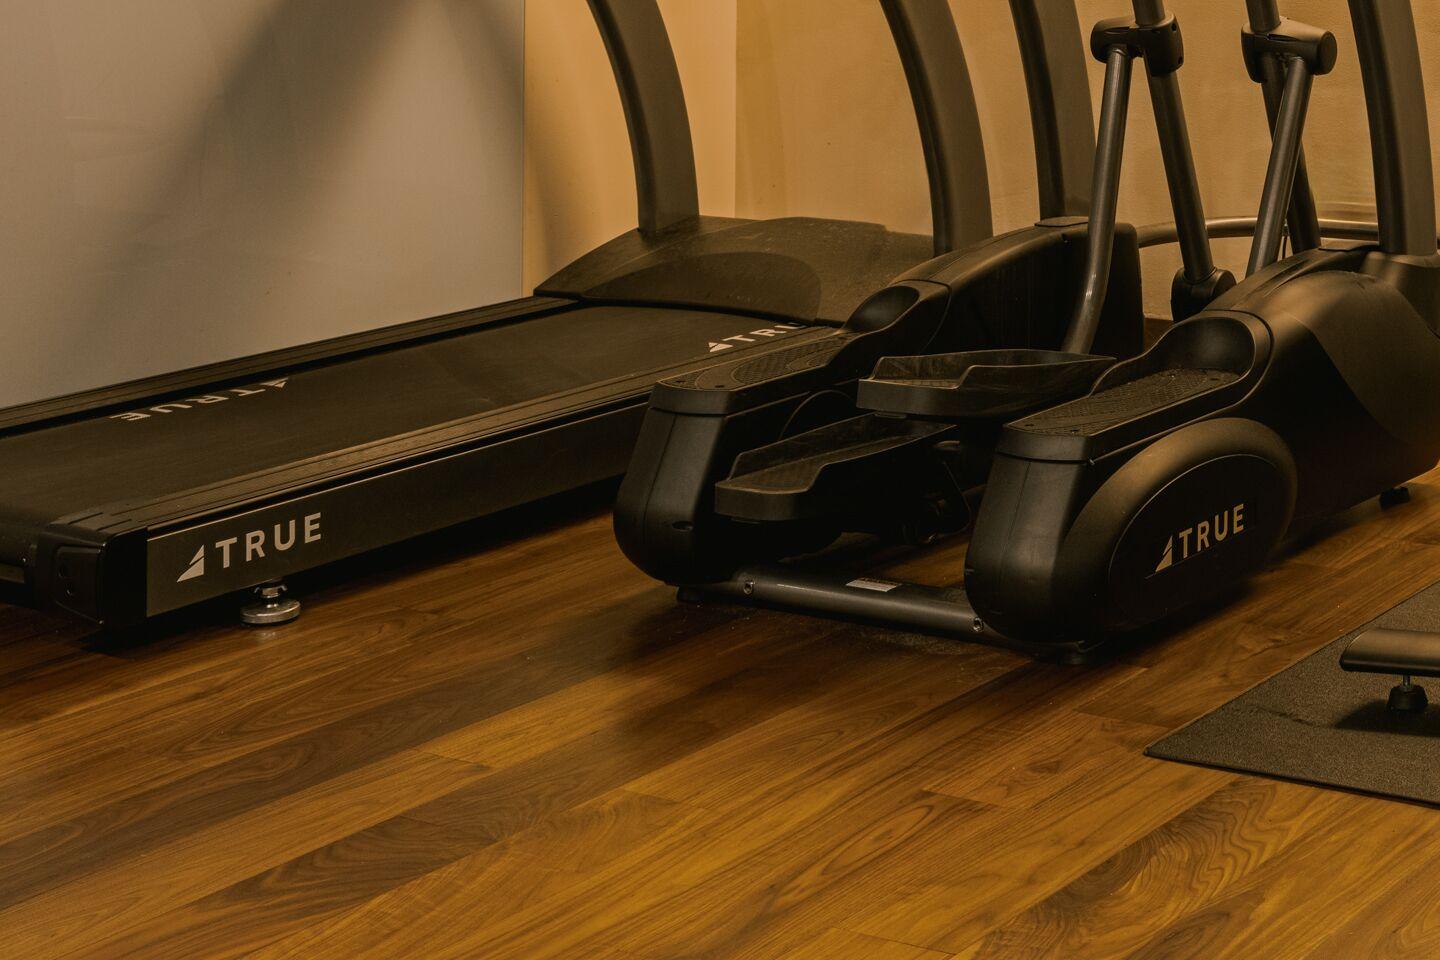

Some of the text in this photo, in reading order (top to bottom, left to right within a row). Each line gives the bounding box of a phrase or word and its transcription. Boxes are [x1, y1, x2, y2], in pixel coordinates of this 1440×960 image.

[722, 322, 807, 342] TRU
[109, 388, 266, 421] TRUE
[215, 512, 322, 569] TRUE
[1179, 503, 1244, 559] TRUE
